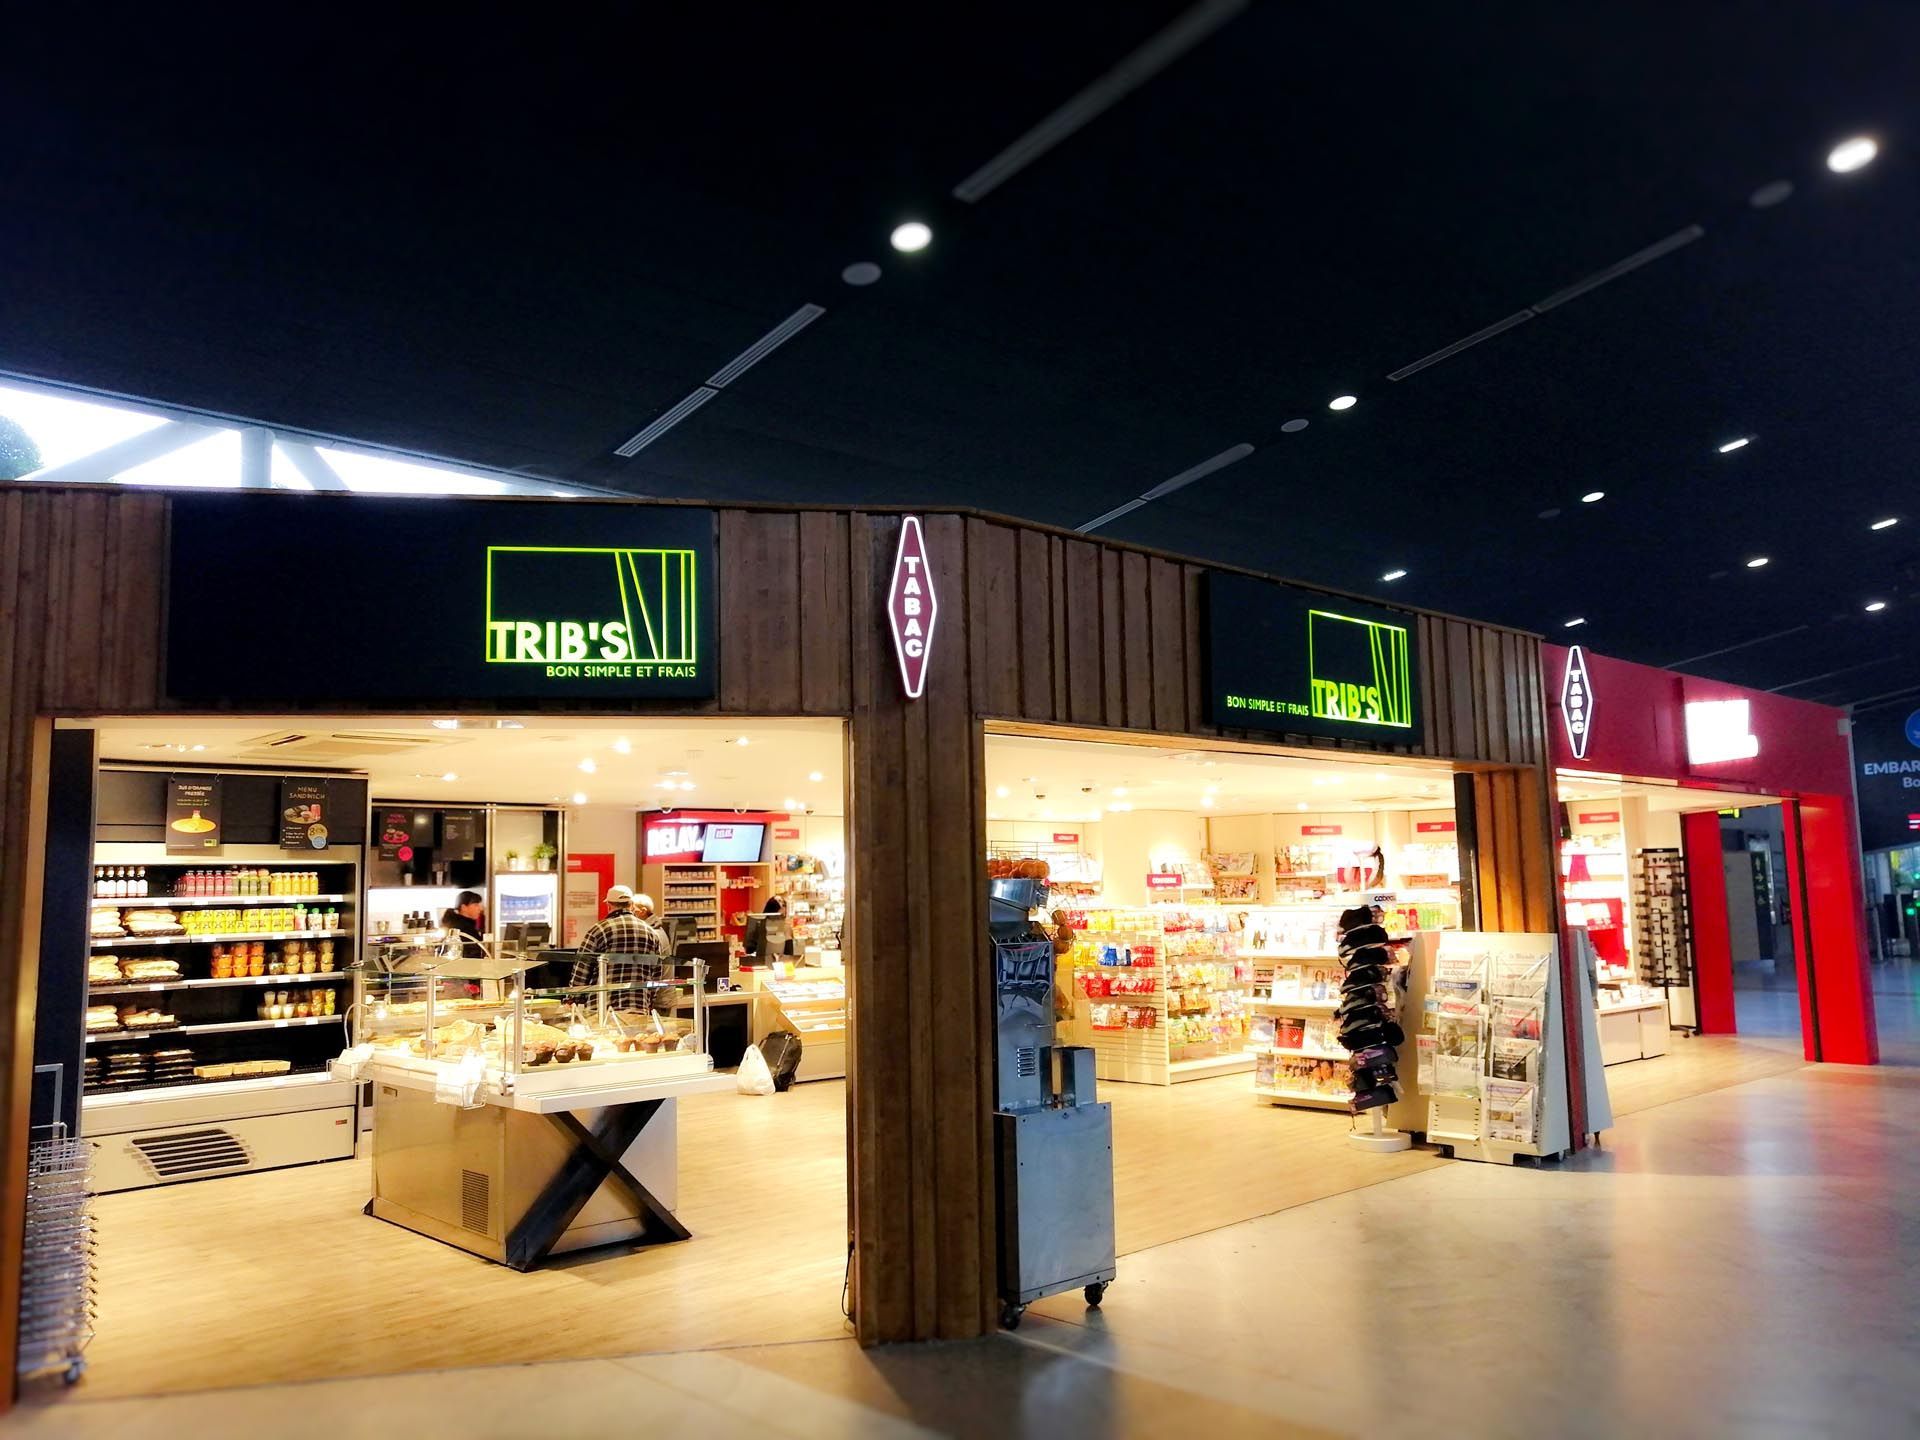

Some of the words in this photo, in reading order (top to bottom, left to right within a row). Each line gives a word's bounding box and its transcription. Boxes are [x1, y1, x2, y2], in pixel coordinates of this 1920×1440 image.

[904, 556, 923, 658] TABAC
[489, 621, 629, 661] TRIB'S
[546, 665, 580, 678] BON
[584, 665, 631, 678] SIMPLE
[636, 665, 653, 678] ET
[658, 665, 696, 678] FRAIS
[1227, 695, 1246, 709] BON
[1248, 698, 1275, 713] SIMPLE
[1276, 701, 1286, 713] ET
[1288, 703, 1309, 716] FRAIS
[1311, 679, 1380, 722] TRIB'S
[1570, 669, 1584, 734] TABAC
